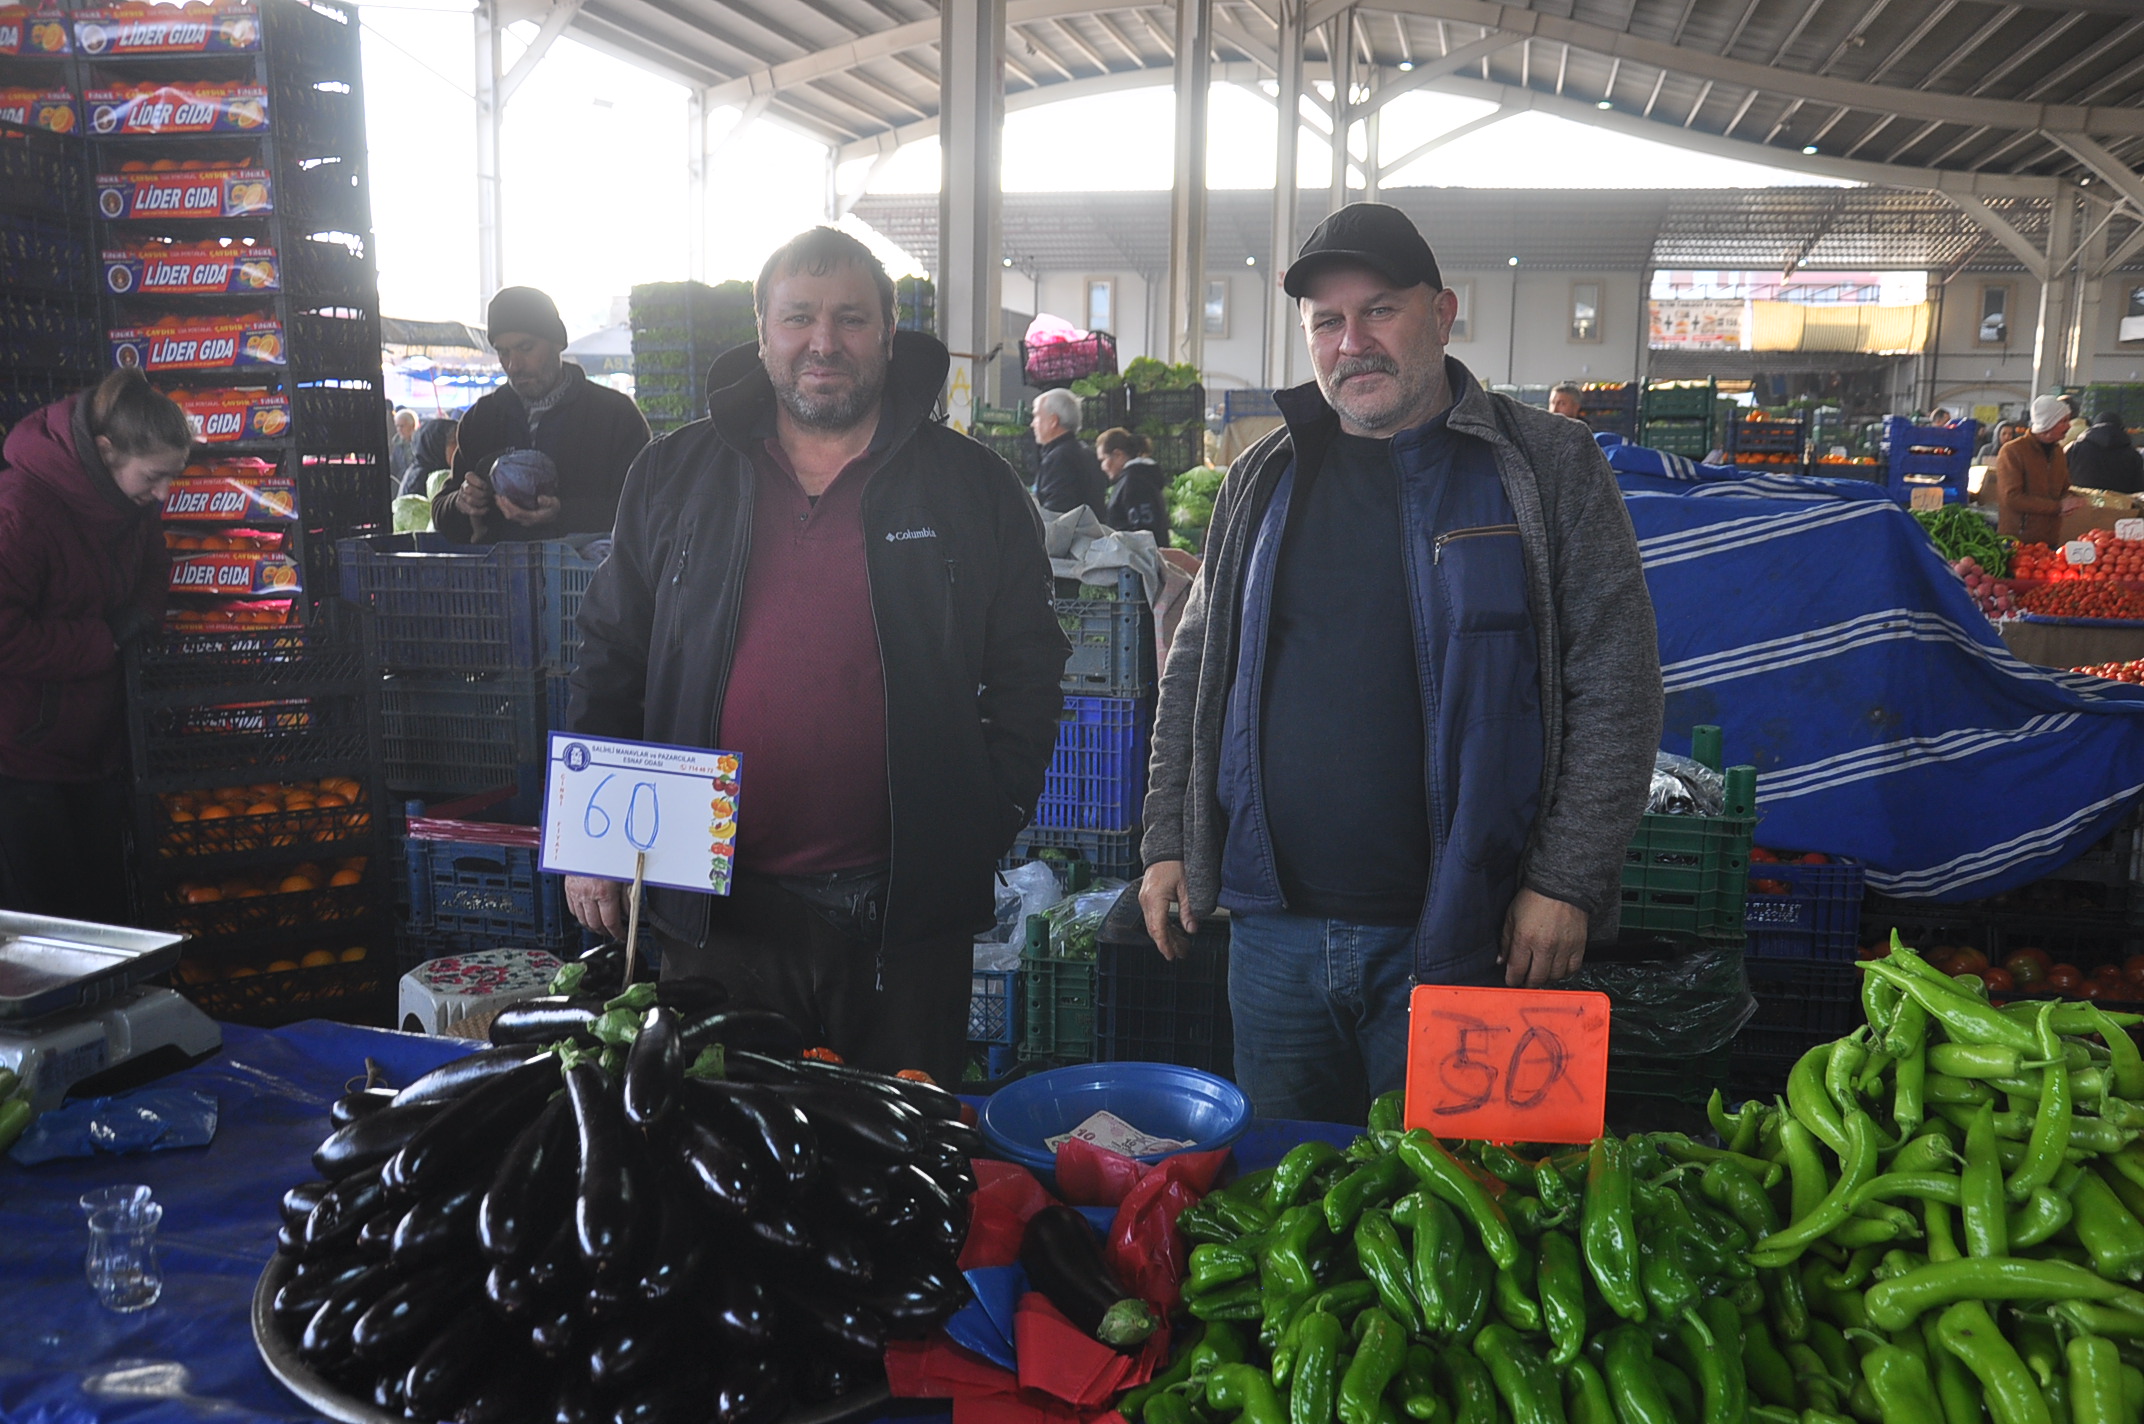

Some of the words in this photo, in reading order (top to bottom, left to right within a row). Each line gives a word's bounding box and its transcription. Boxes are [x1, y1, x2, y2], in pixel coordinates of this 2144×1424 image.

[0, 25, 18, 46] DA
[118, 21, 168, 47] LİDER
[167, 22, 207, 45] GIDA
[129, 100, 174, 127] LİDER
[174, 103, 215, 125] GIDA
[135, 184, 182, 210] LİDER
[183, 186, 219, 209] GIDA
[144, 260, 190, 286] LİDER
[192, 263, 228, 285] GIDA
[151, 337, 198, 363] LİDER
[199, 338, 234, 360] GIDA
[206, 412, 242, 435] GIDA
[166, 489, 209, 513] LİDER
[209, 491, 247, 513] GIDA
[895, 526, 937, 541] Columbia
[2071, 546, 2095, 563] 50
[172, 561, 216, 585] LİDER
[217, 565, 250, 585] GIDA
[615, 747, 650, 758] MANAVLAR
[657, 753, 696, 763] PAZARCILAR
[583, 772, 660, 851] 60
[1077, 1127, 1097, 1141] 10
